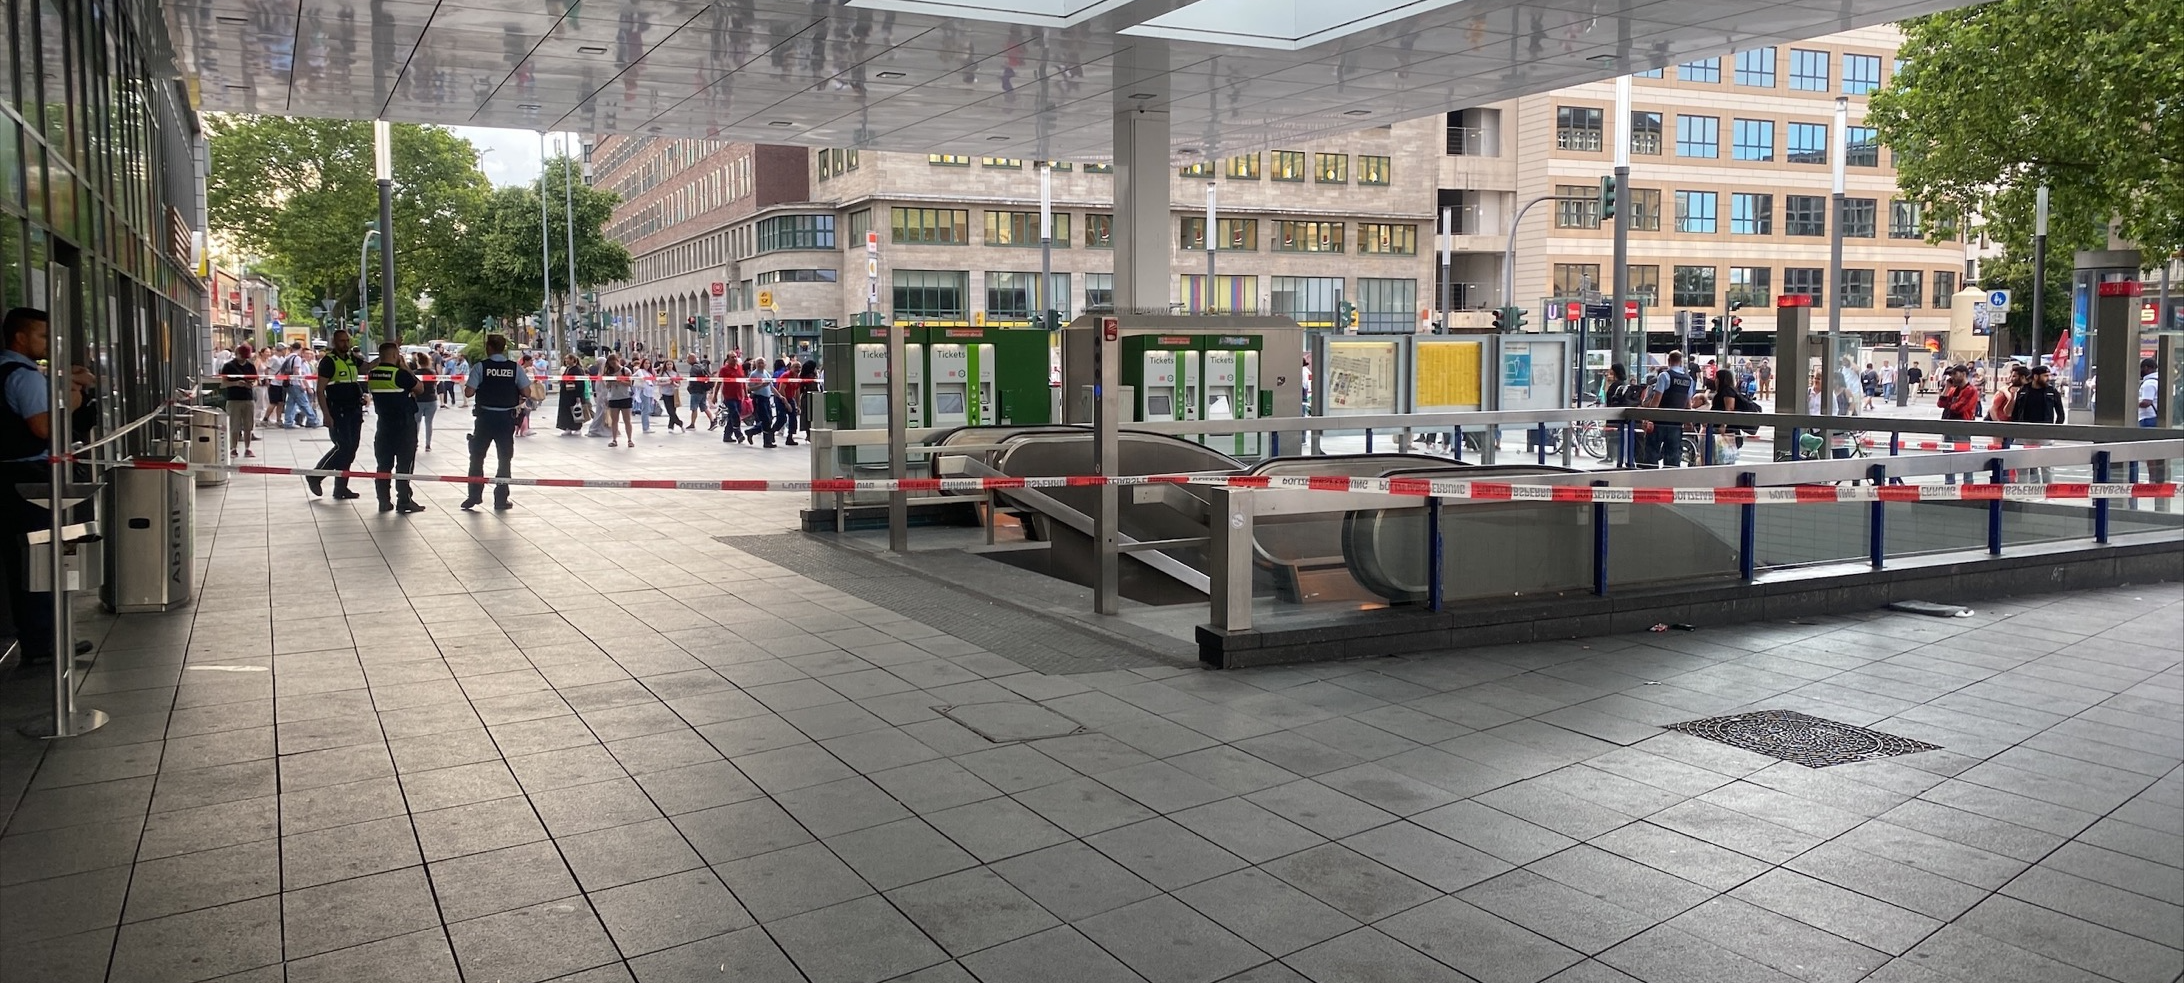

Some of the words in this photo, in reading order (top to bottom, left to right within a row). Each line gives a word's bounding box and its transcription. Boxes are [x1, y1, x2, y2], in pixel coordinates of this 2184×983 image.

[1548, 304, 1557, 320] U
[862, 350, 888, 359] Ticket
[937, 350, 966, 359] Tickets
[1149, 356, 1174, 365] Tickets
[1210, 356, 1234, 364] Tickets
[486, 368, 514, 378] POLIZEI
[172, 510, 181, 584] Abfall
